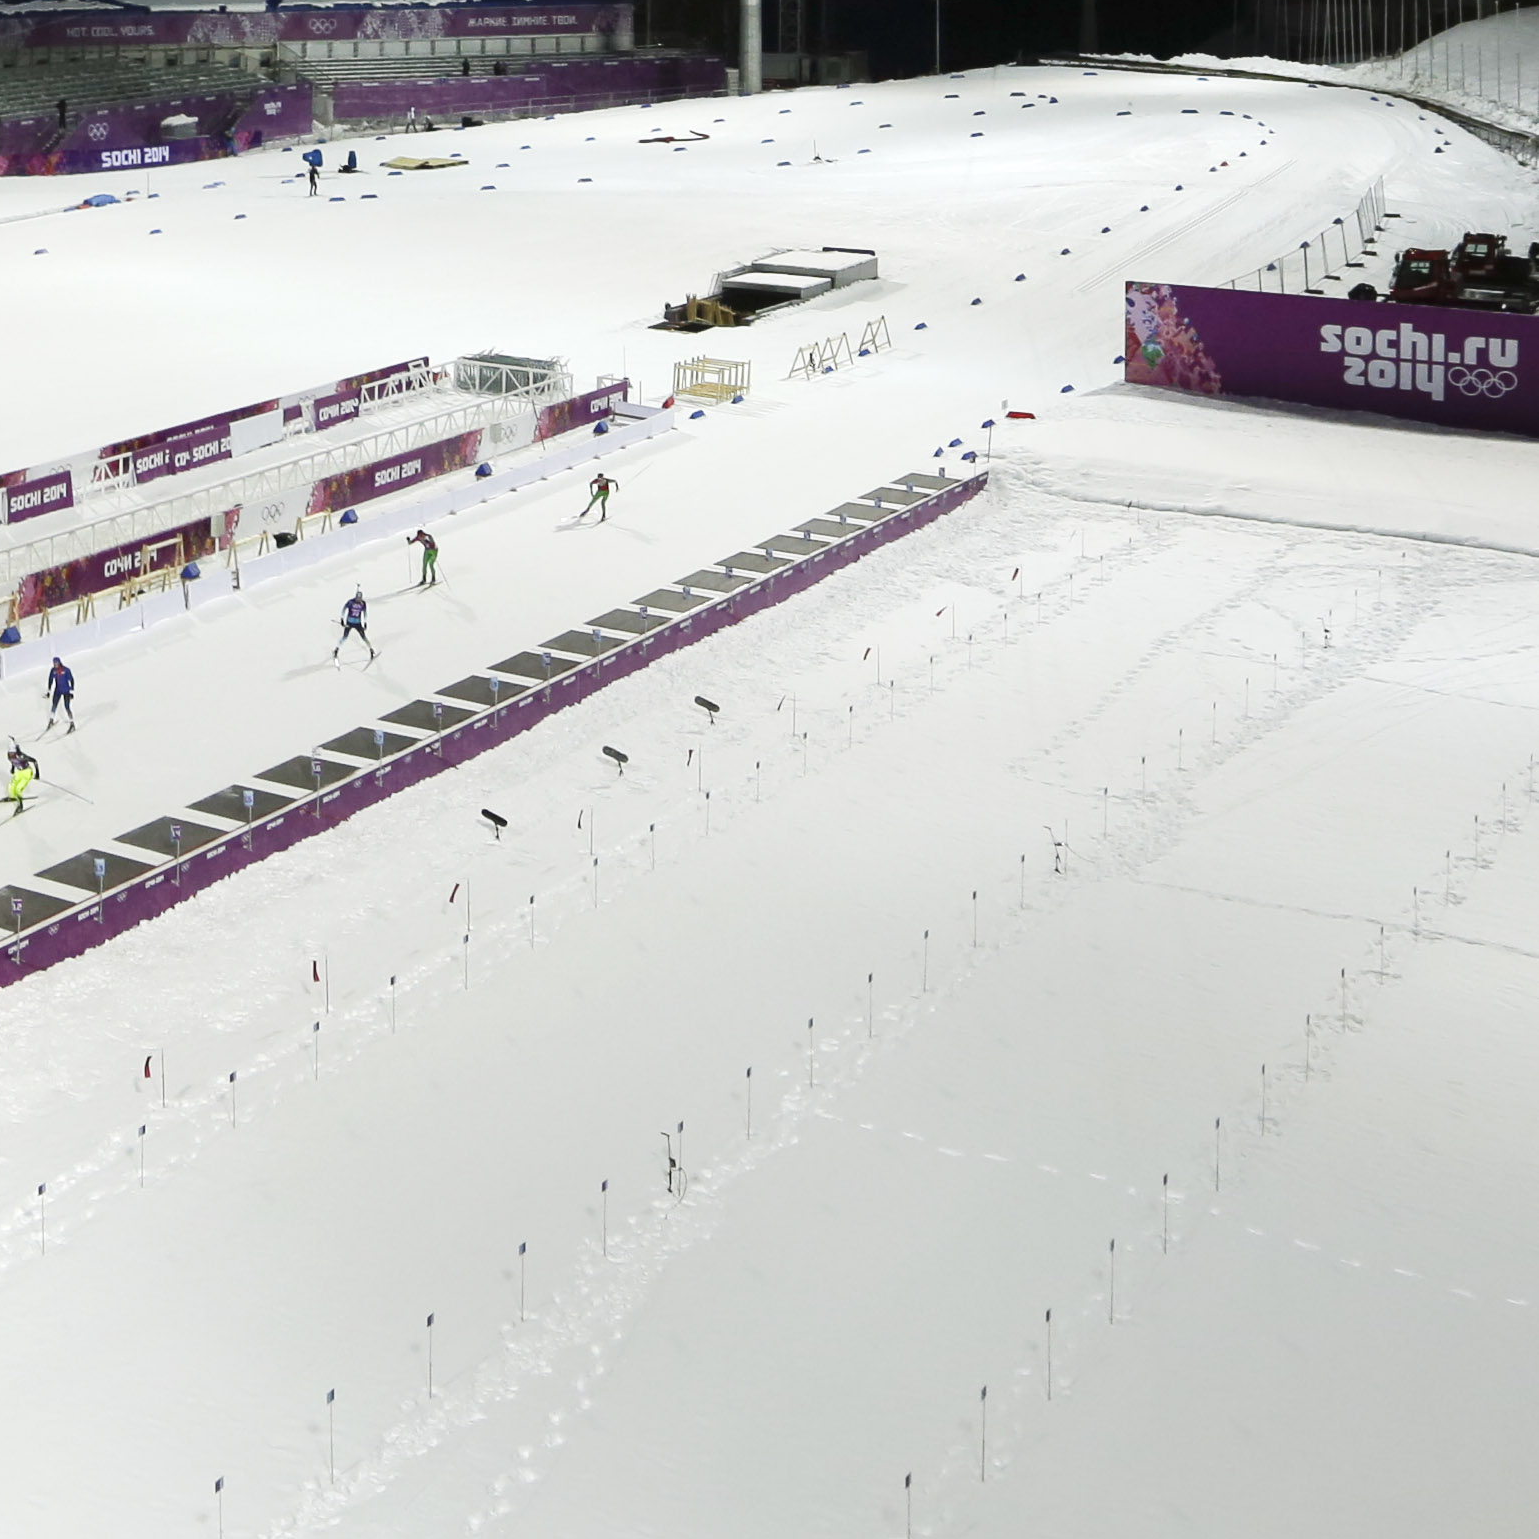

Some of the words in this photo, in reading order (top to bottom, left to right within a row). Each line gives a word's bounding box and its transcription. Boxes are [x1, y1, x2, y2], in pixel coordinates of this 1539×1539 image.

[101, 149, 141, 167] SOCHI
[144, 146, 169, 163] 2014
[1320, 322, 1518, 368] sochi.ru
[1343, 357, 1445, 402] 2014
[136, 452, 164, 474] SOCHI
[192, 440, 219, 463] SOCHI
[375, 468, 400, 487] SOCHI
[401, 458, 421, 478] 2014
[10, 490, 41, 513] SOCHI
[43, 482, 67, 503] 2014
[104, 554, 132, 578] СОЧИ
